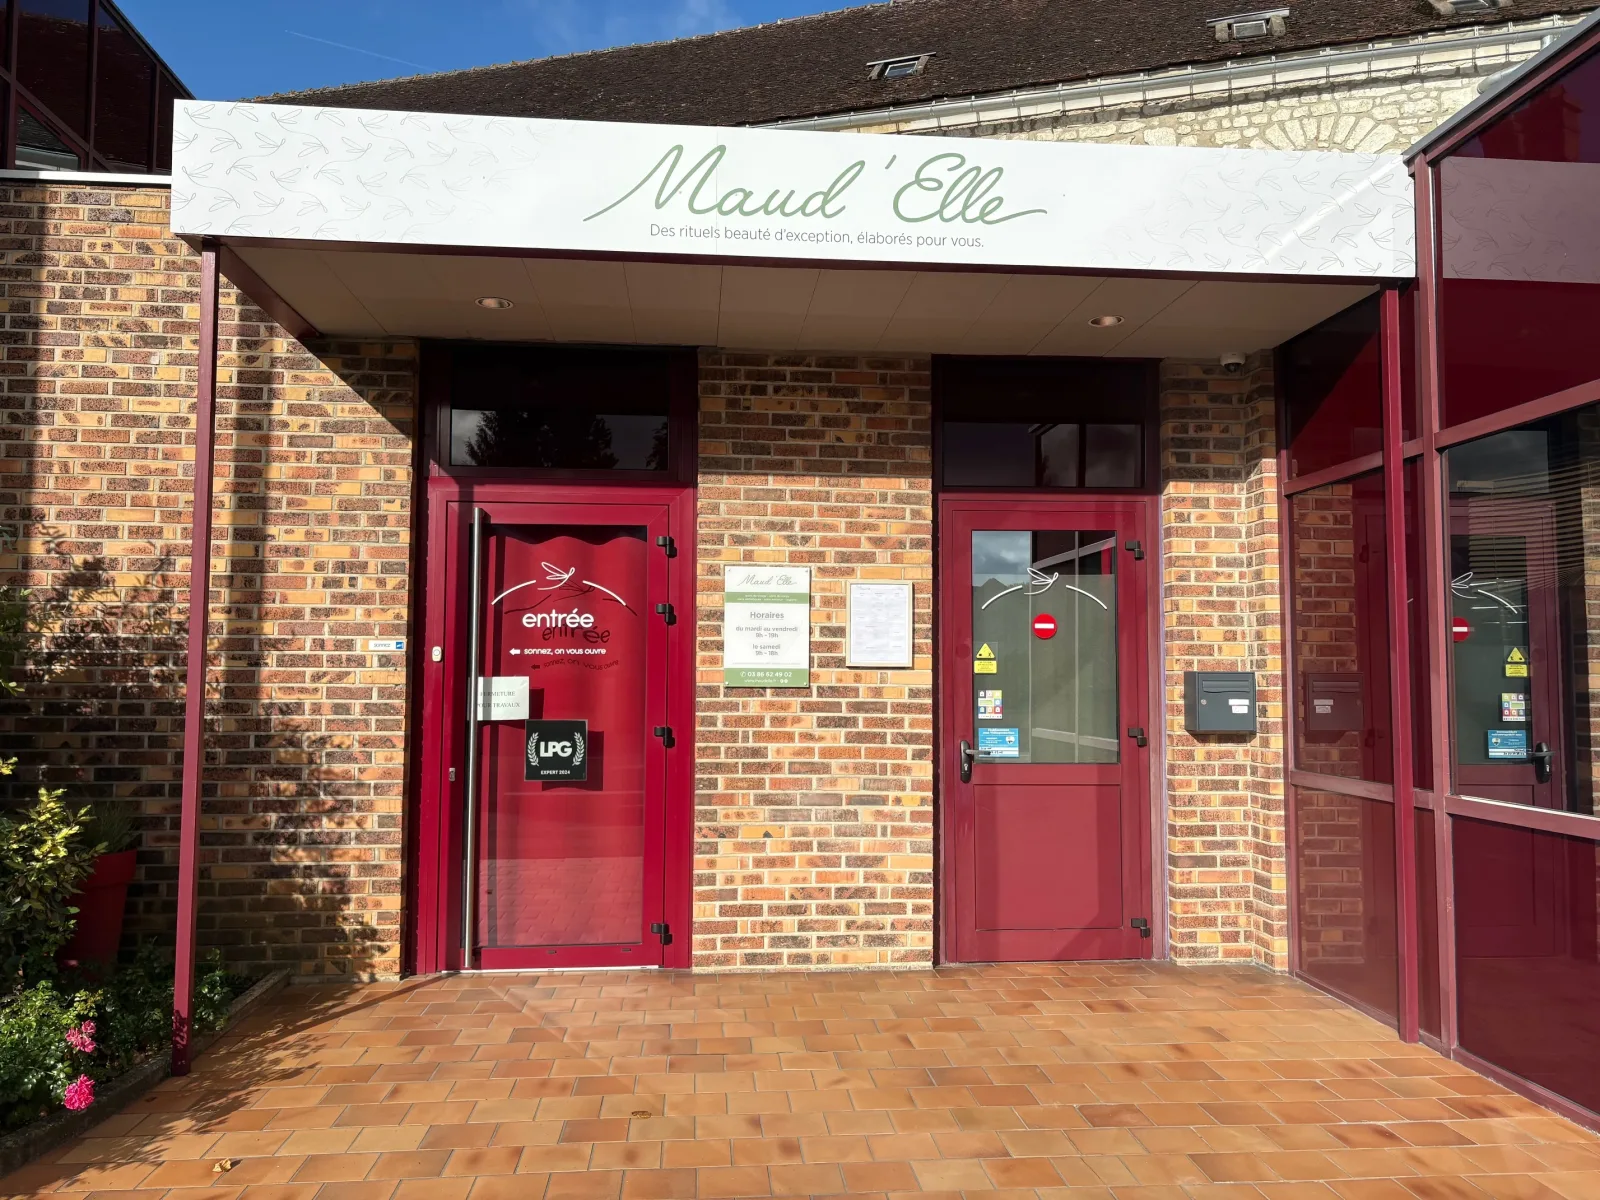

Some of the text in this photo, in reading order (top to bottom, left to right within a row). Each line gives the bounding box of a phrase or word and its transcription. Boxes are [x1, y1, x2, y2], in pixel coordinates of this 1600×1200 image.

[650, 223, 984, 248] Des rituels beauté d'exception, élaborés pour vous.
[522, 608, 595, 628] entrée
[750, 611, 785, 619] Horaires
[523, 648, 554, 656] sonnez,
[540, 741, 573, 758] LPG
